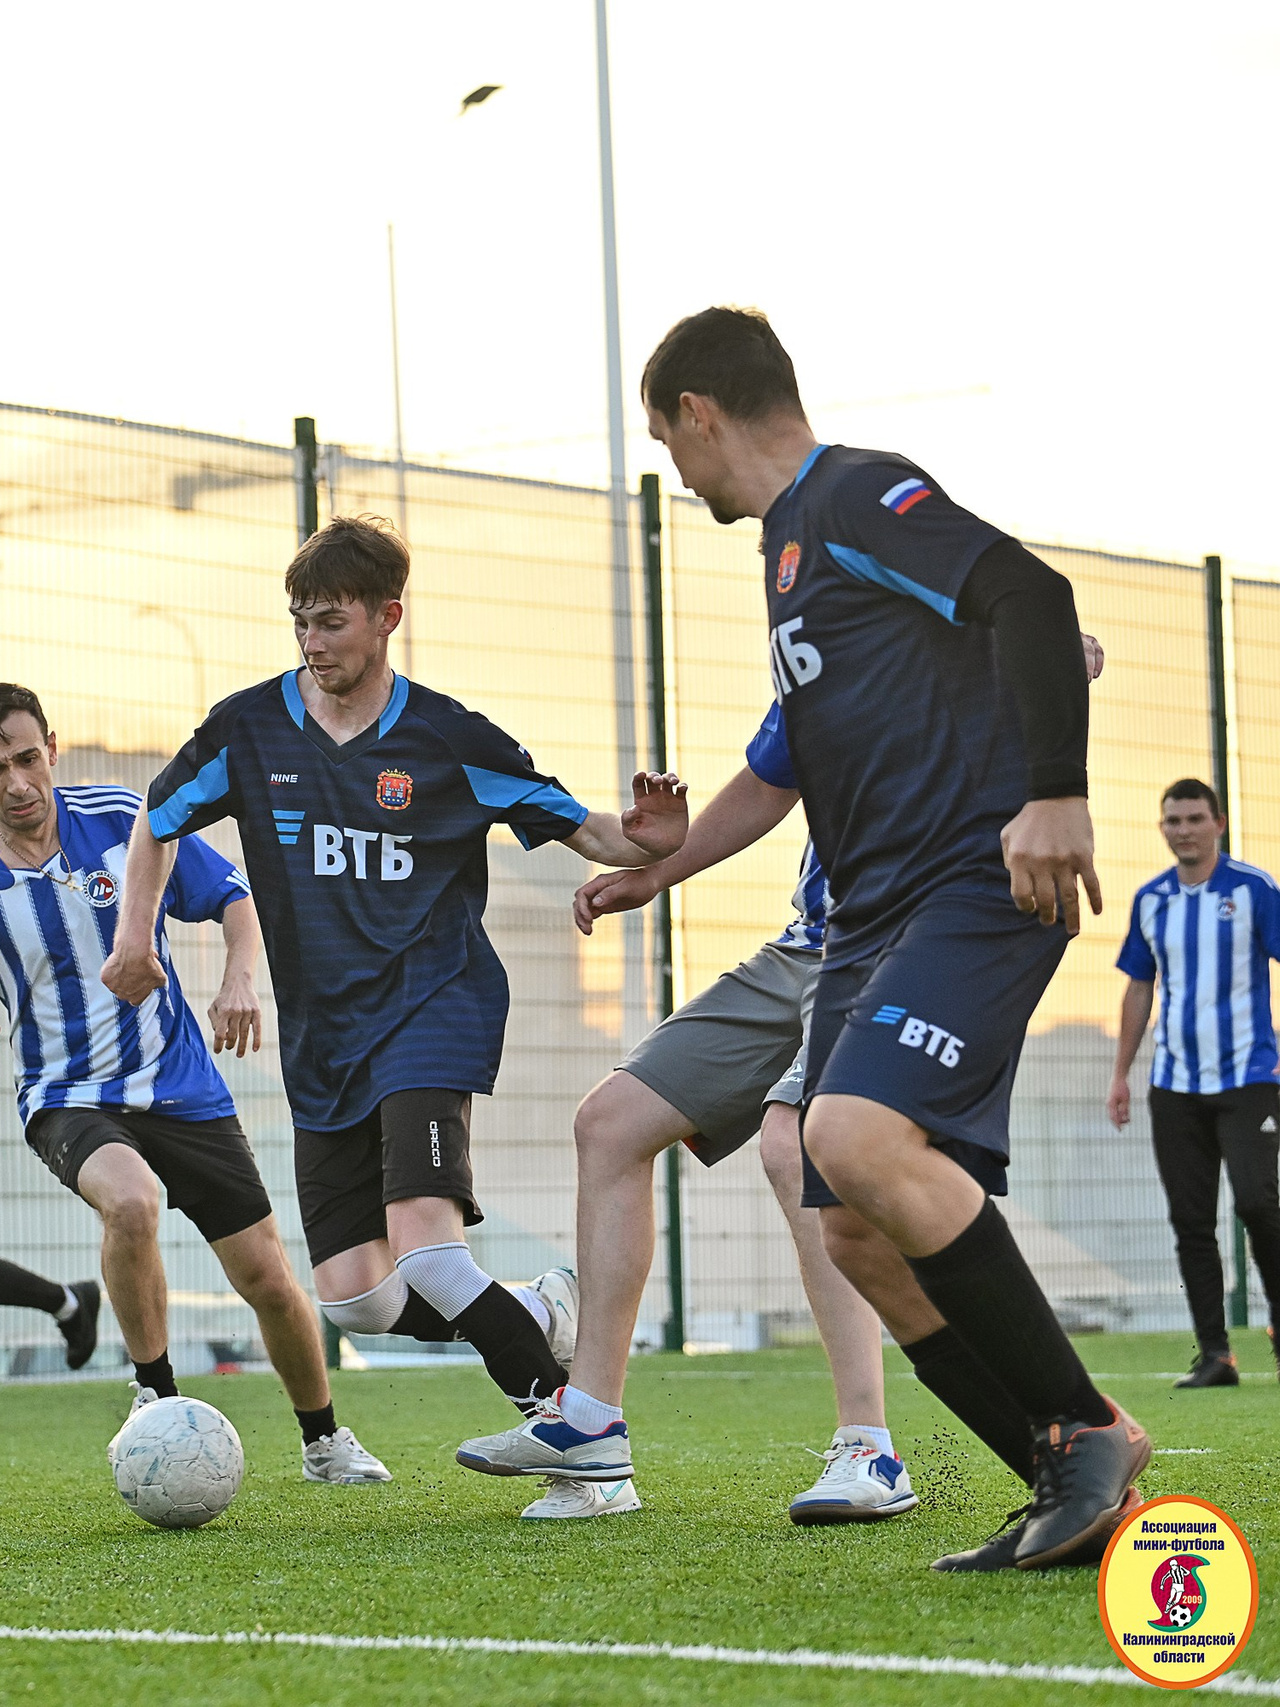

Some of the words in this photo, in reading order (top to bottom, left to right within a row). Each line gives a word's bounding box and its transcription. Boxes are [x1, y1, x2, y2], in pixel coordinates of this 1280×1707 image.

[770, 615, 823, 706] ТБ
[270, 772, 299, 784] NINE
[313, 824, 414, 881] ВТБ
[898, 1016, 966, 1069] ВТБ
